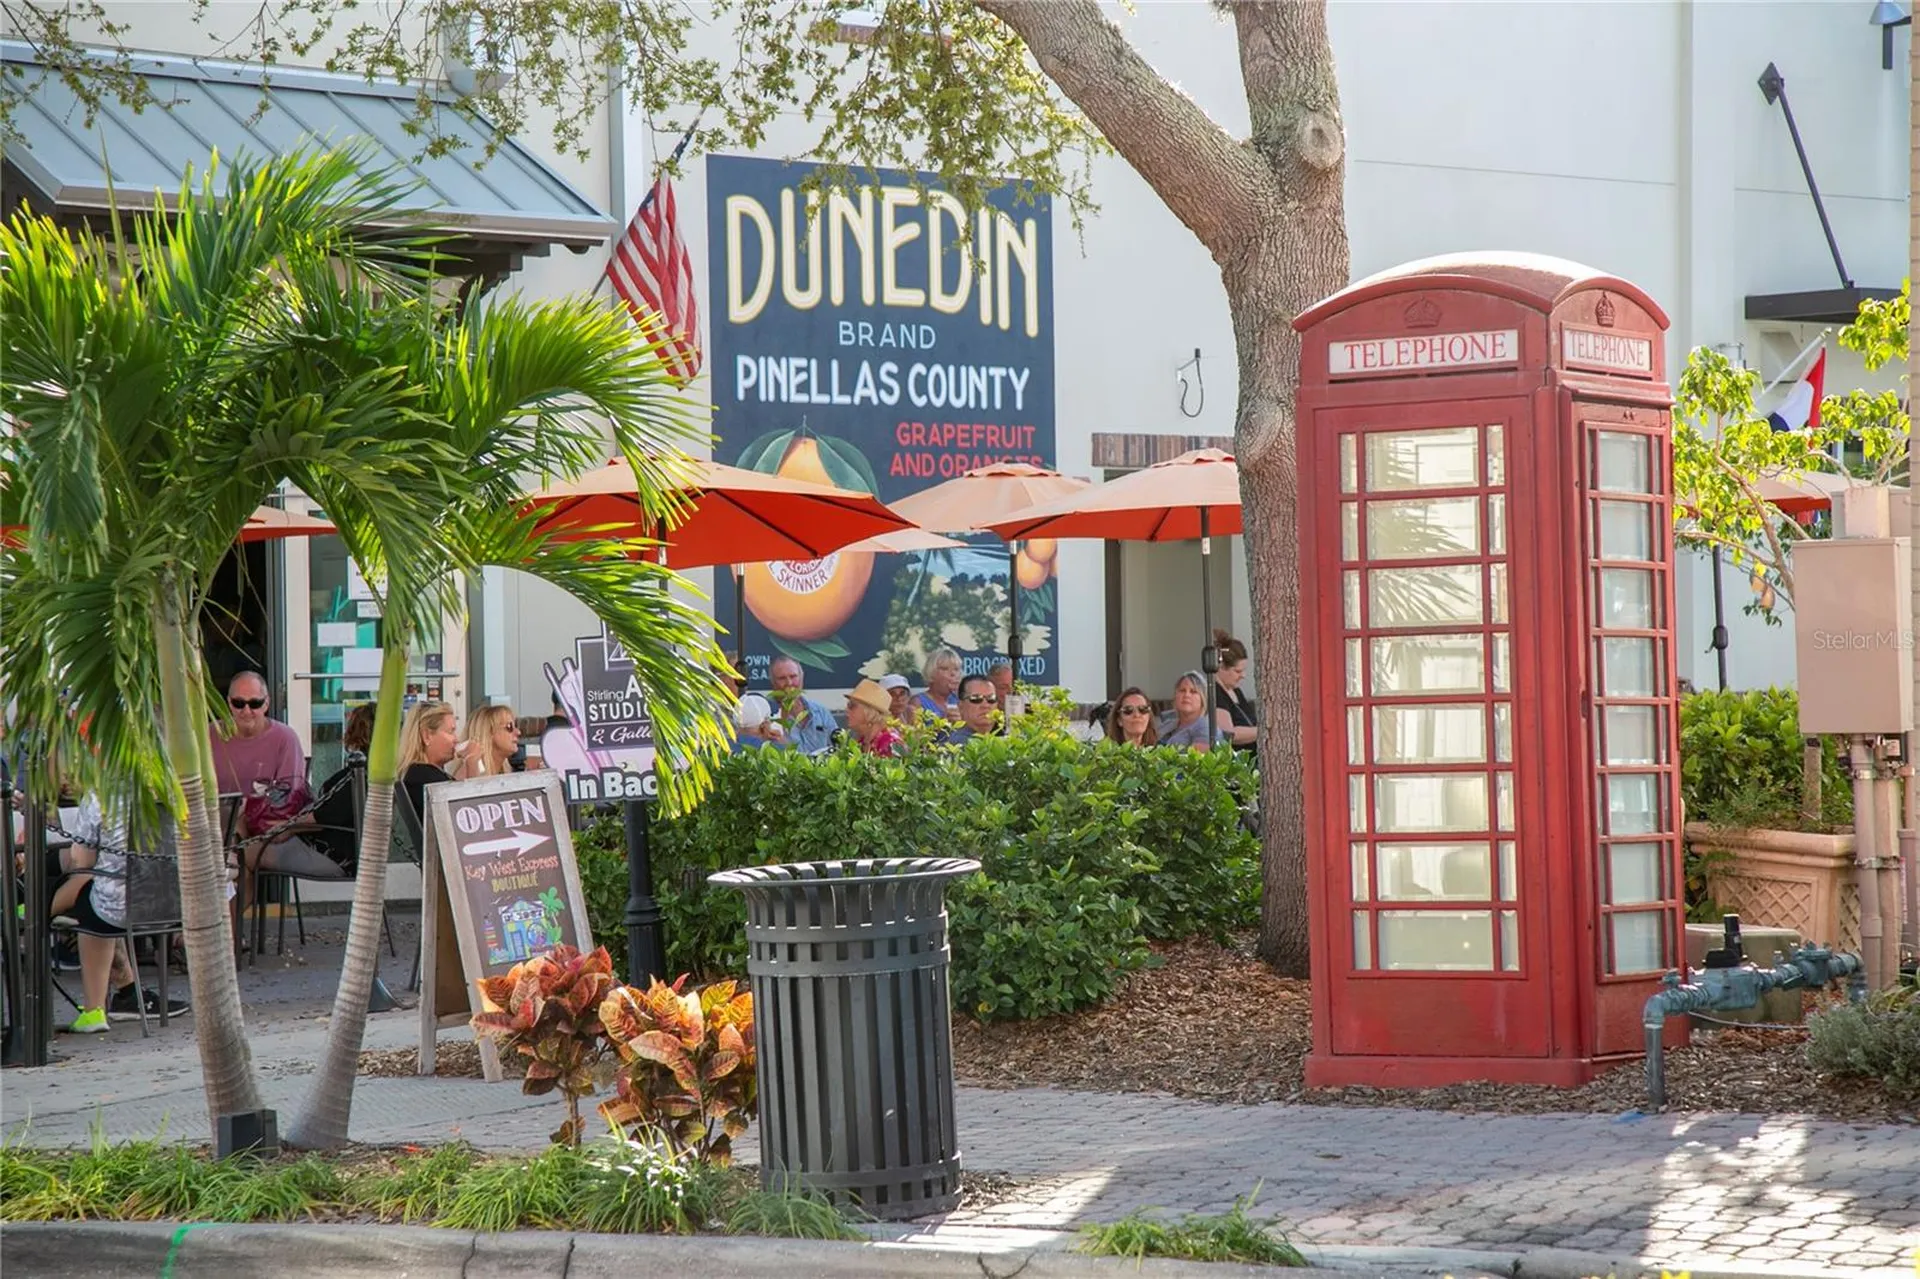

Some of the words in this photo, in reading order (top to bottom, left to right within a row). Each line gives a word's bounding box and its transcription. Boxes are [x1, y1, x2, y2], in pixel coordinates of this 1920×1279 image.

[726, 185, 1039, 338] DUNEDIN
[839, 321, 936, 349] BRAND
[1569, 331, 1645, 366] TELEPHONE
[1344, 332, 1507, 369] TELEPHONE
[736, 355, 900, 405] PINELLAS
[908, 364, 1031, 410] COUNTY
[896, 422, 1036, 449] GRAPEFRUIT
[890, 452, 935, 477] AND
[939, 453, 1043, 477] ORAS
[777, 568, 828, 592] SKINNER
[744, 655, 770, 666] OWN
[587, 690, 624, 702] Stirling
[589, 701, 650, 721] STUDI
[592, 728, 605, 744] &
[568, 774, 598, 800] In
[603, 771, 658, 798] Bac
[456, 796, 547, 833] OPEN
[464, 865, 486, 881] Key
[488, 860, 517, 876] West
[518, 855, 559, 873] Express
